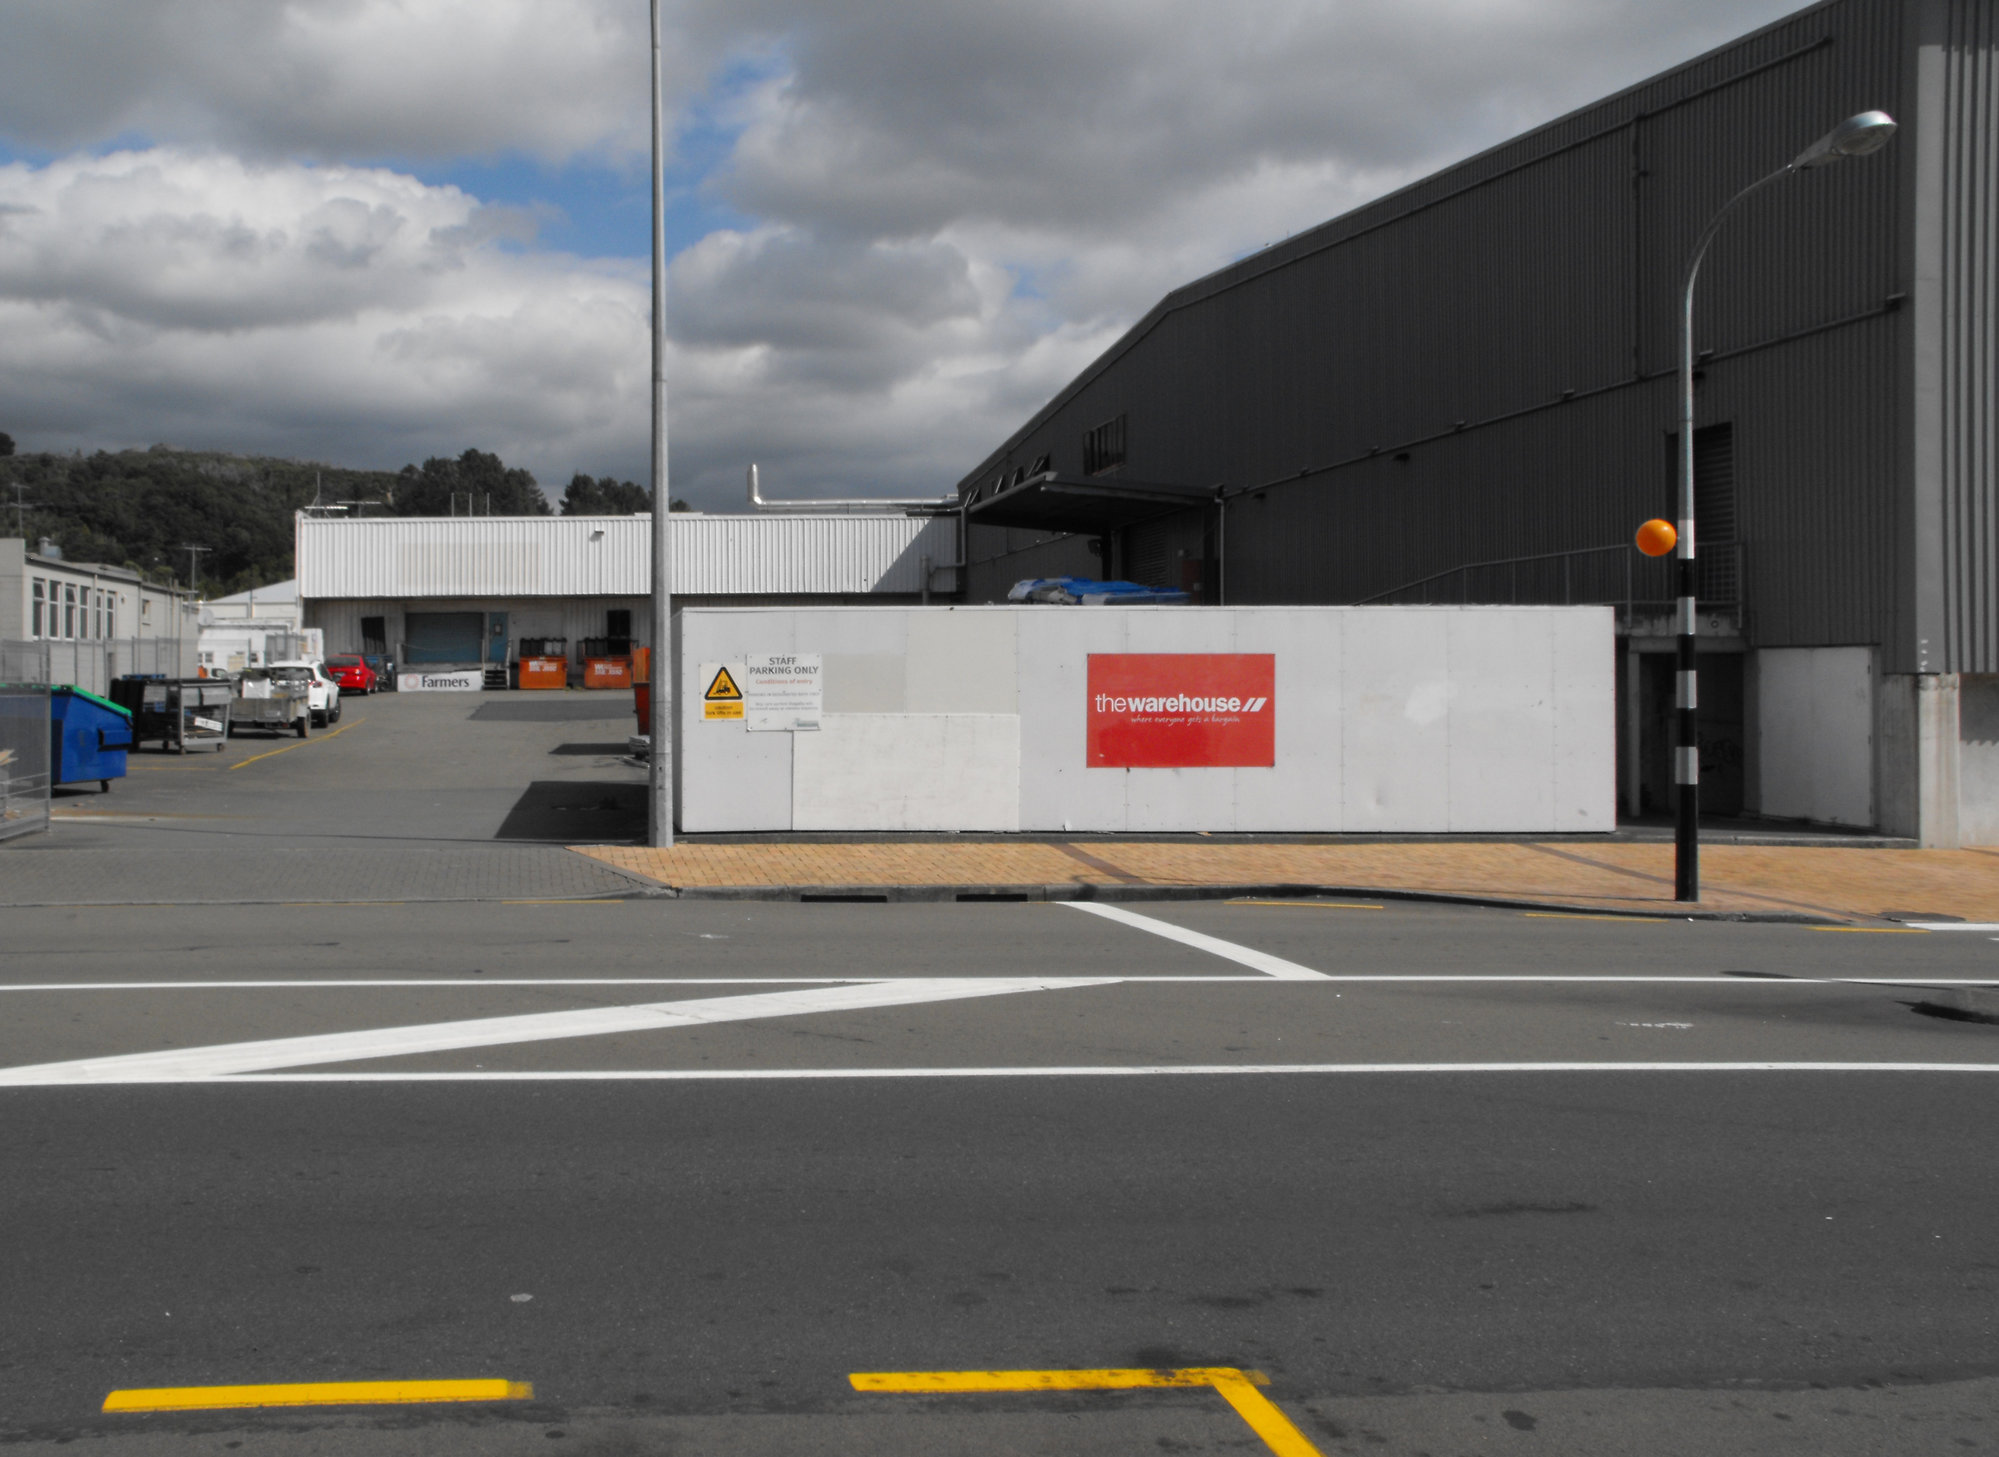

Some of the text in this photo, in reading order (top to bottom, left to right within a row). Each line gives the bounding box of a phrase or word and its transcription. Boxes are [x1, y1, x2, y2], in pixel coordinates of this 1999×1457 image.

[769, 656, 797, 665] STAFF
[749, 666, 819, 675] PARKING ONLY
[422, 675, 469, 688] Farmers
[1131, 713, 1153, 723] where
[1155, 716, 1185, 727] everyone
[1187, 714, 1202, 727] gets
[1211, 713, 1240, 727] bargain
